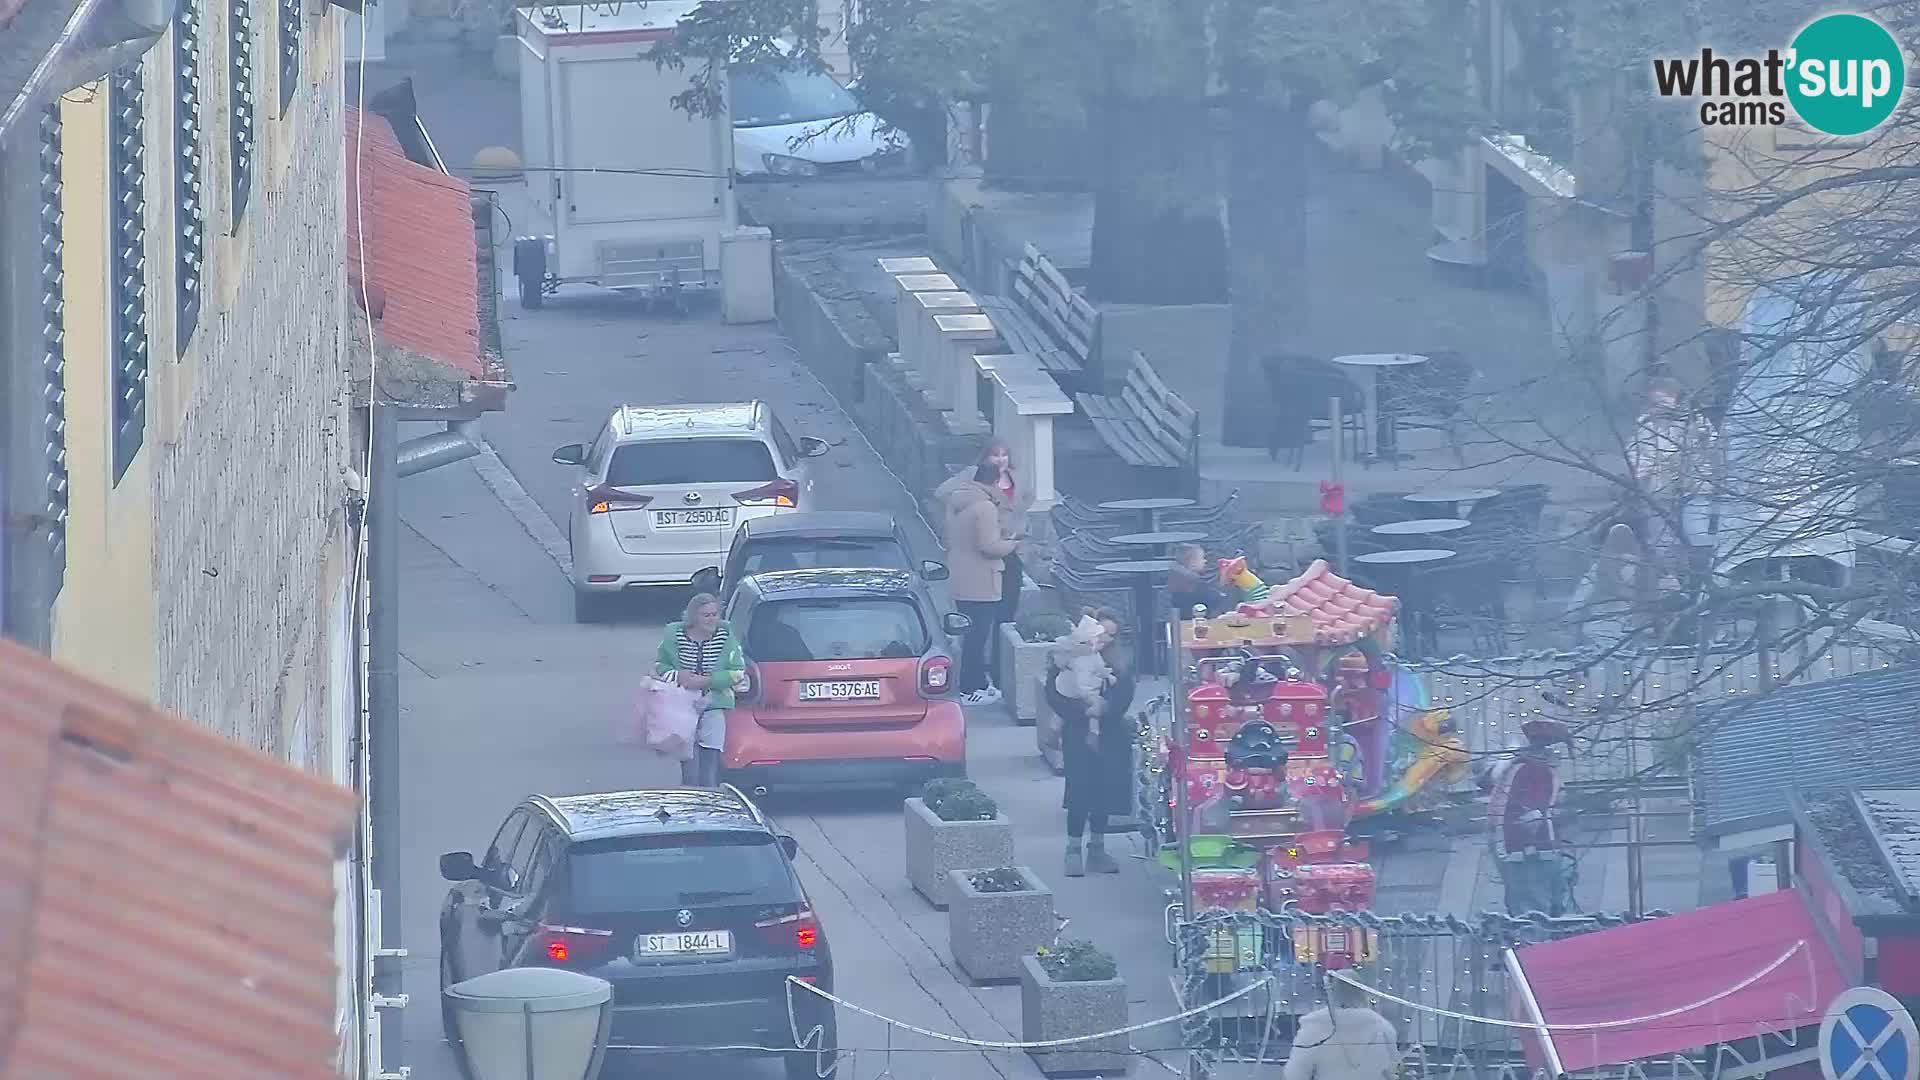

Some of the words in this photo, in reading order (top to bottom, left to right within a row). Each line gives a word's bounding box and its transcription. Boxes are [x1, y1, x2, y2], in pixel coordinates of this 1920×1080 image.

[664, 512, 677, 524] ST
[808, 684, 823, 696] ST
[649, 936, 664, 950] ST
[678, 934, 722, 949] 1844-L
